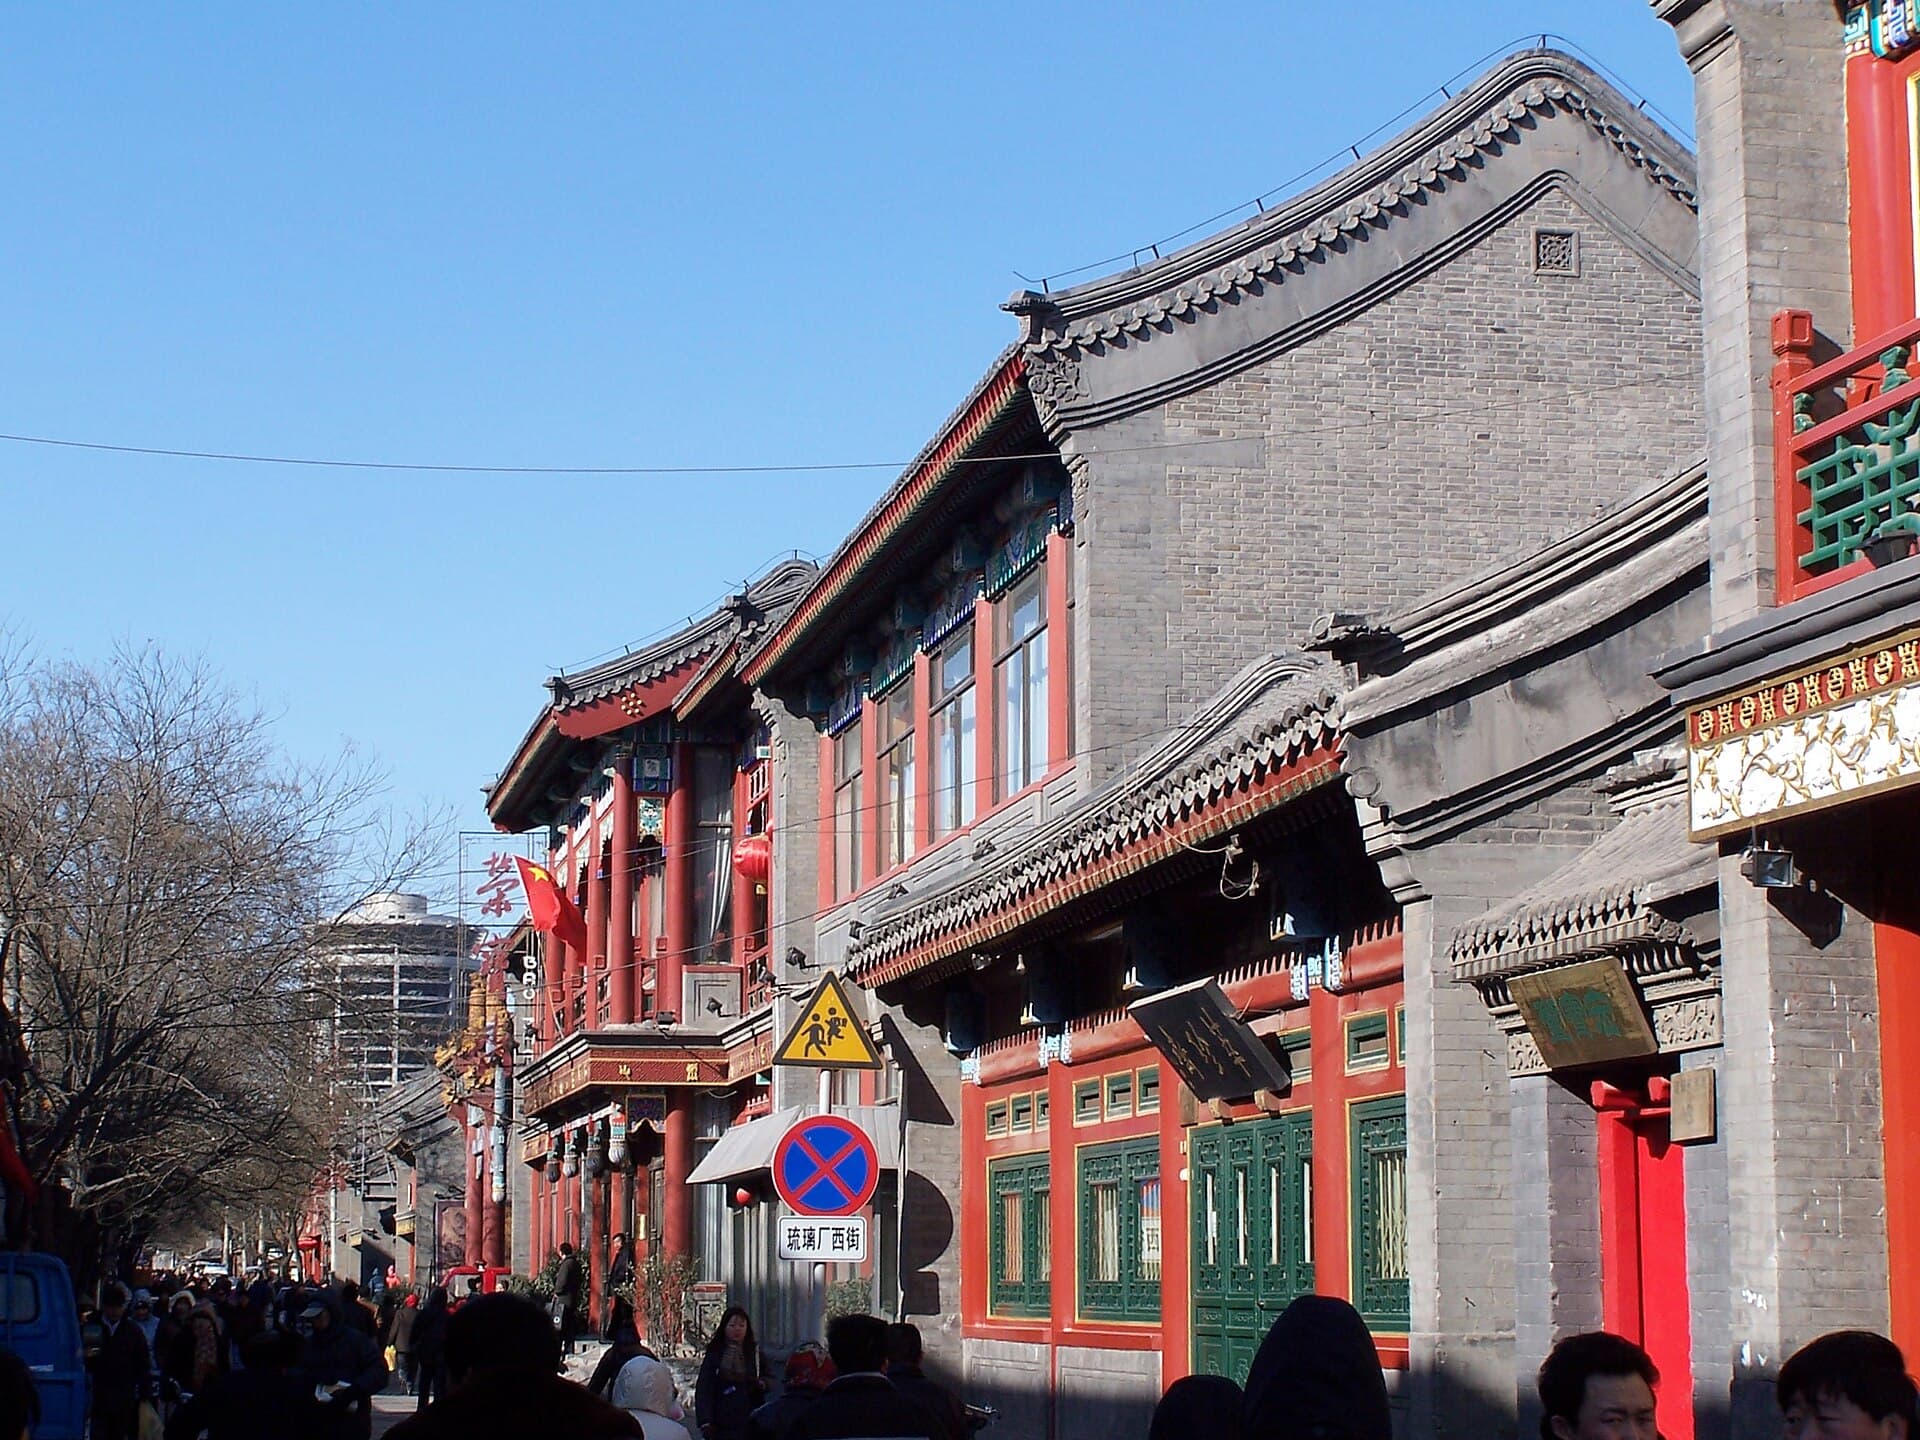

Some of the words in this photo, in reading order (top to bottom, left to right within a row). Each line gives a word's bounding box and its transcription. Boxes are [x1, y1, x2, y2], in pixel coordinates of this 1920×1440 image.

[523, 955, 537, 1000] BAO
[787, 1226, 860, 1251] 琉璃厂西街
